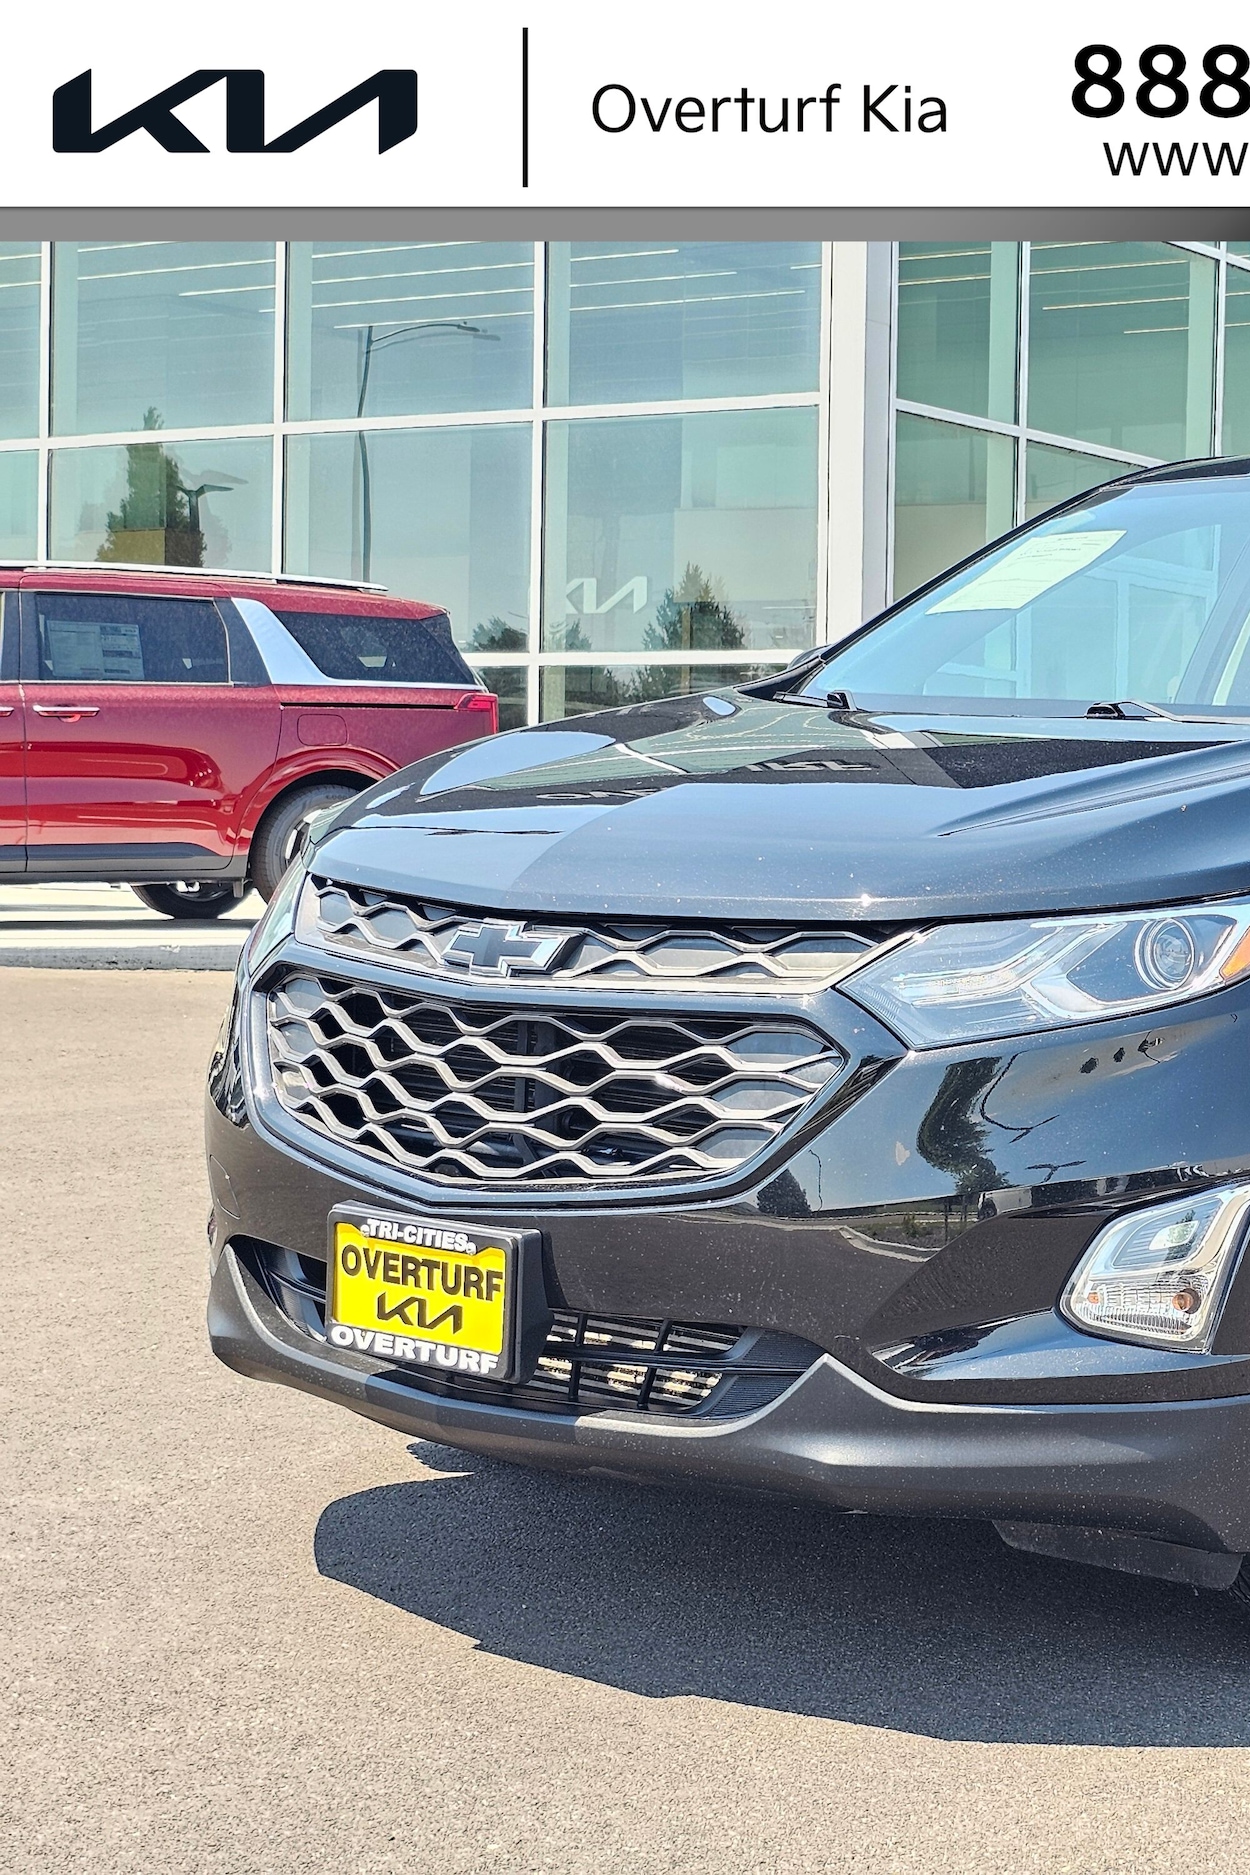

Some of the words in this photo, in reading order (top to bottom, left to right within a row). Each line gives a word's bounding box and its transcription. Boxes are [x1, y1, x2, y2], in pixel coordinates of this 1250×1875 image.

[366, 1218, 470, 1250] TRI-CITIES
[341, 1244, 504, 1302] OVERTURF
[376, 1291, 463, 1335] KIA
[330, 1324, 499, 1375] OVERTURF
